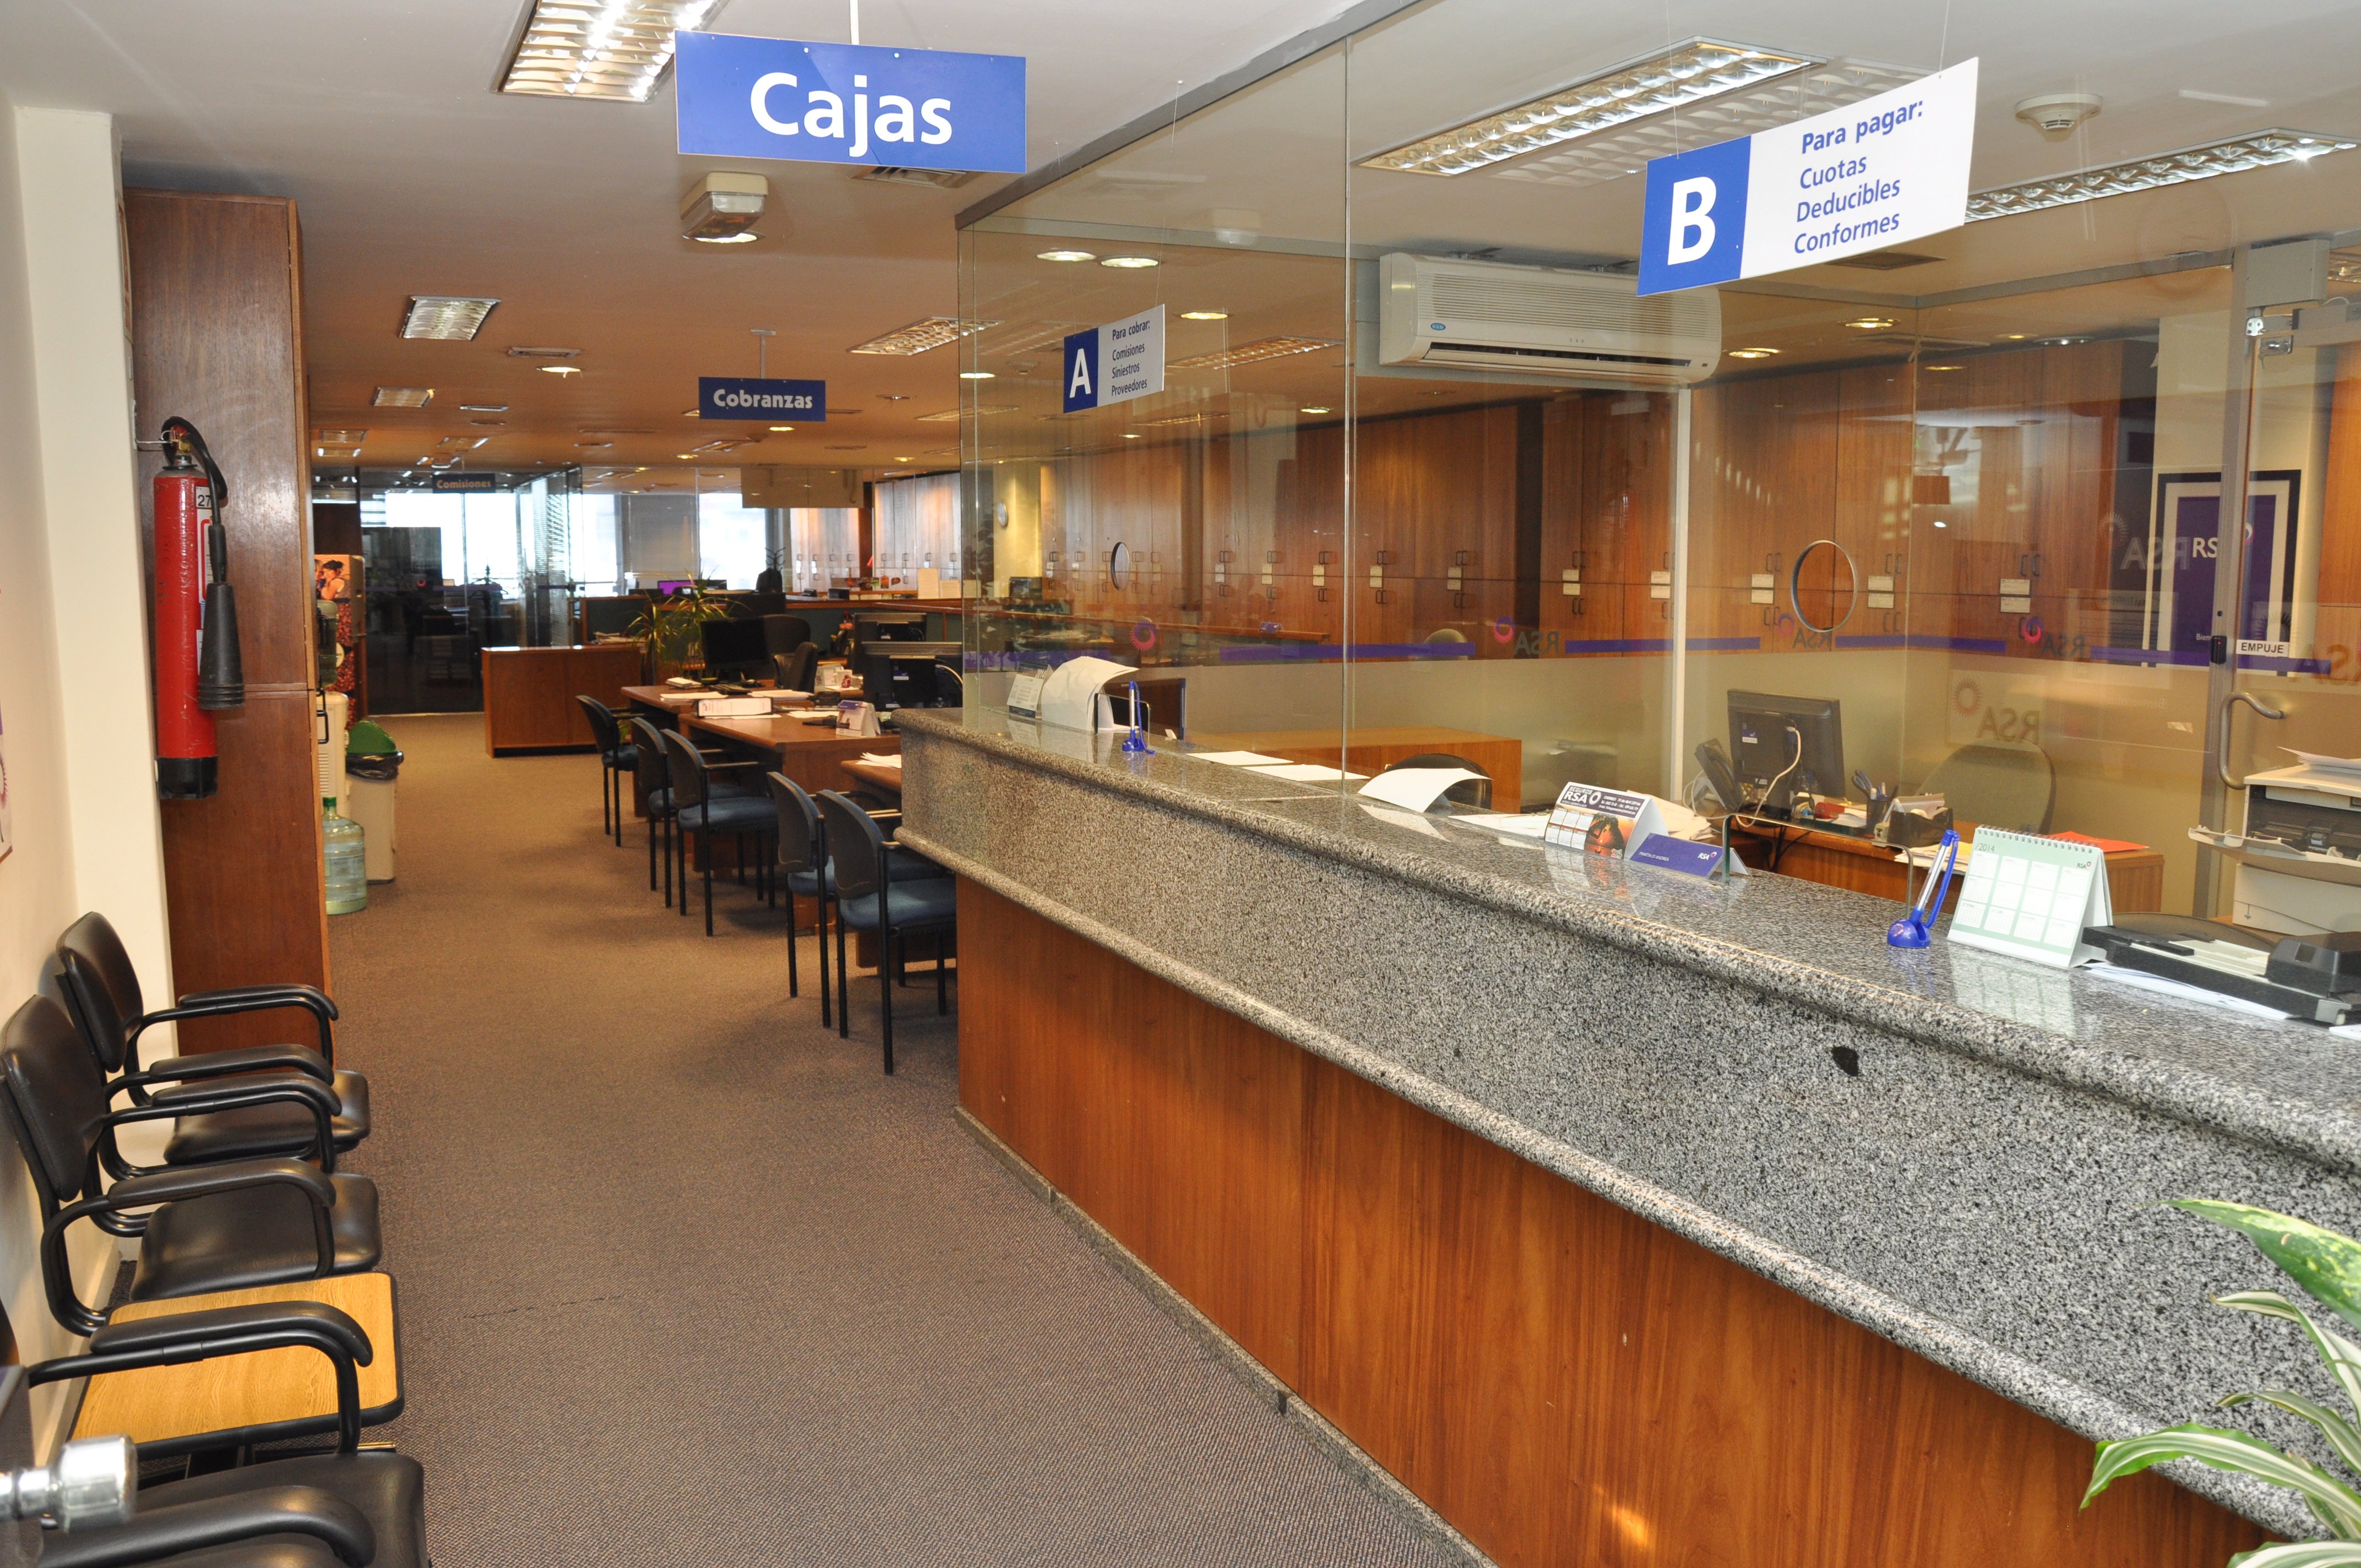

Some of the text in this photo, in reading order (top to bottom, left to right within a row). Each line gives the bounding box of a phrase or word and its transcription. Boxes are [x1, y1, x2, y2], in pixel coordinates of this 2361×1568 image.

[750, 72, 952, 157] Cajas
[1802, 100, 1923, 154] Para pagar:
[1800, 156, 1867, 189] Cuotas
[1797, 179, 1901, 222] Deducibles
[1667, 176, 1717, 265] B
[1794, 213, 1900, 254] Conformes
[1112, 320, 1150, 340] Para cobrar:
[1112, 343, 1145, 361] Comisiones
[1069, 348, 1091, 398] A
[1112, 363, 1140, 379] Siniestros
[1111, 379, 1147, 396] Proveedores
[714, 389, 812, 409] Cobranzas
[437, 480, 491, 489] Comisiones
[2193, 537, 2217, 558] RS
[2241, 643, 2284, 654] EMPUJE
[1563, 791, 1587, 804] RSA
[1569, 786, 1593, 794] SEGUROS
